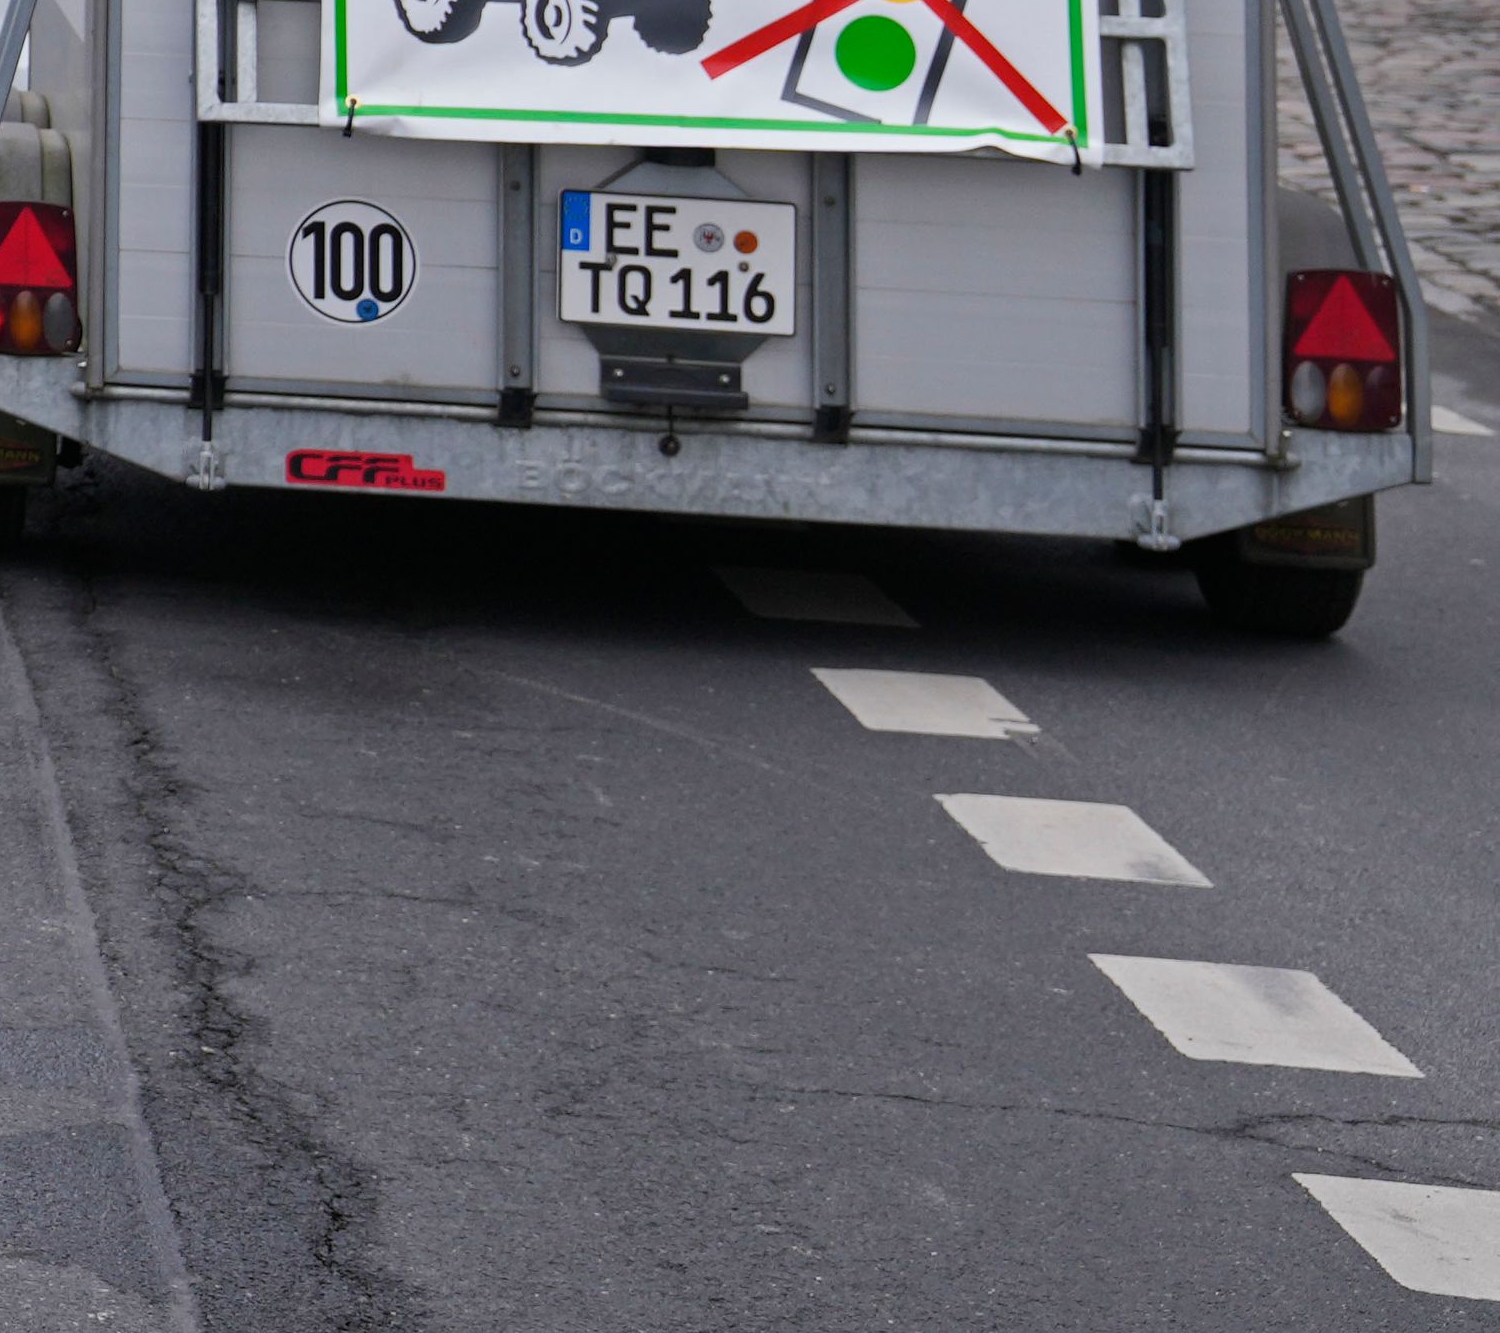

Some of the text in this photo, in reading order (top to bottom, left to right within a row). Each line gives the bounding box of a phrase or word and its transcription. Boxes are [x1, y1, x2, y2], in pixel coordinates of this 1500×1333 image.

[569, 228, 583, 246] D
[604, 202, 680, 259] EE
[301, 220, 405, 304] 100
[579, 261, 776, 325] TQ 116
